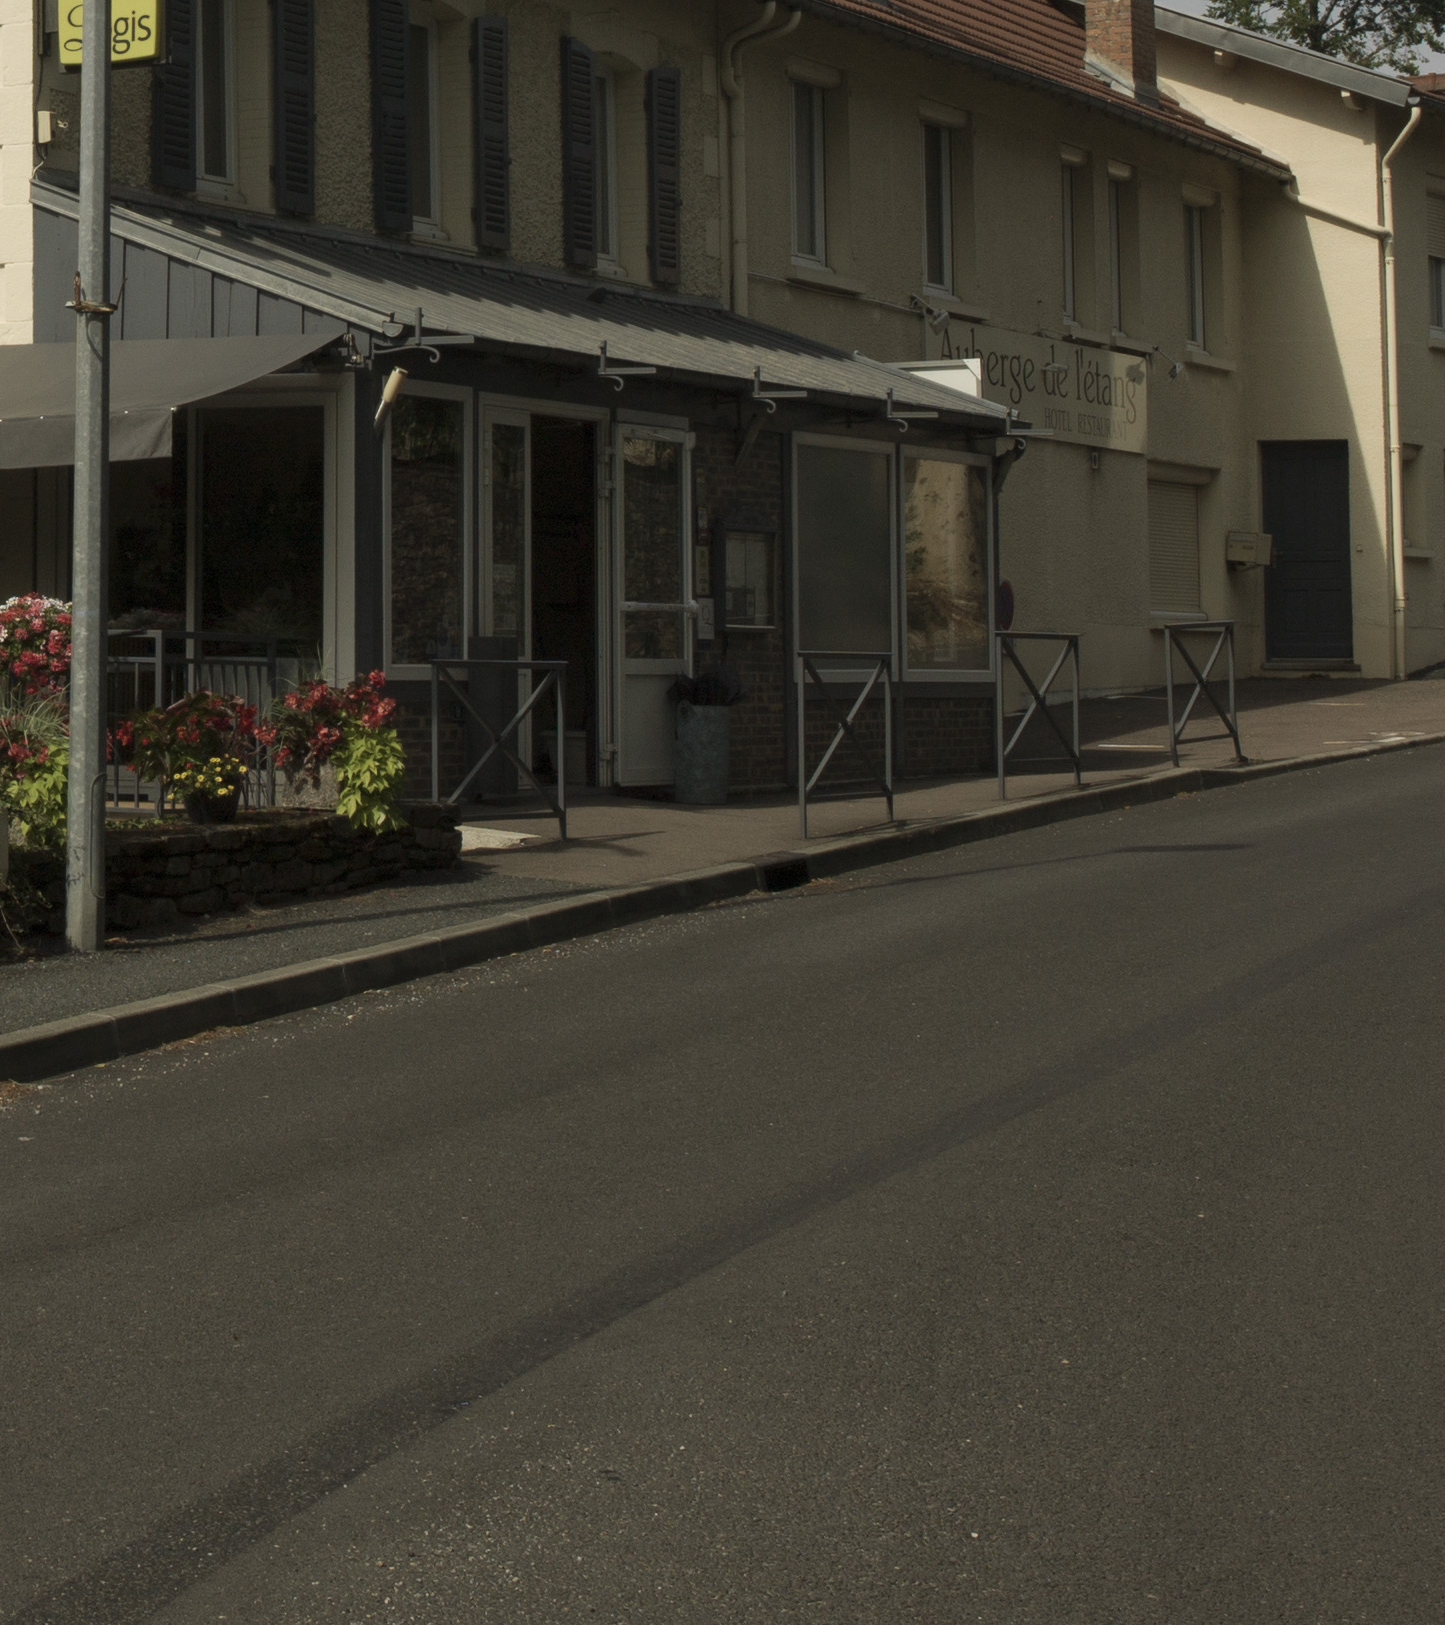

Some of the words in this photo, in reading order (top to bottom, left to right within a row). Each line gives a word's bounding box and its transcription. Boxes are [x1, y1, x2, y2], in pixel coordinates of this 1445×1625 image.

[1042, 343, 1068, 398] de
[1076, 348, 1136, 424] l'étang
[1044, 407, 1072, 432] HOTEL
[1077, 413, 1128, 442] RESTAURANT
